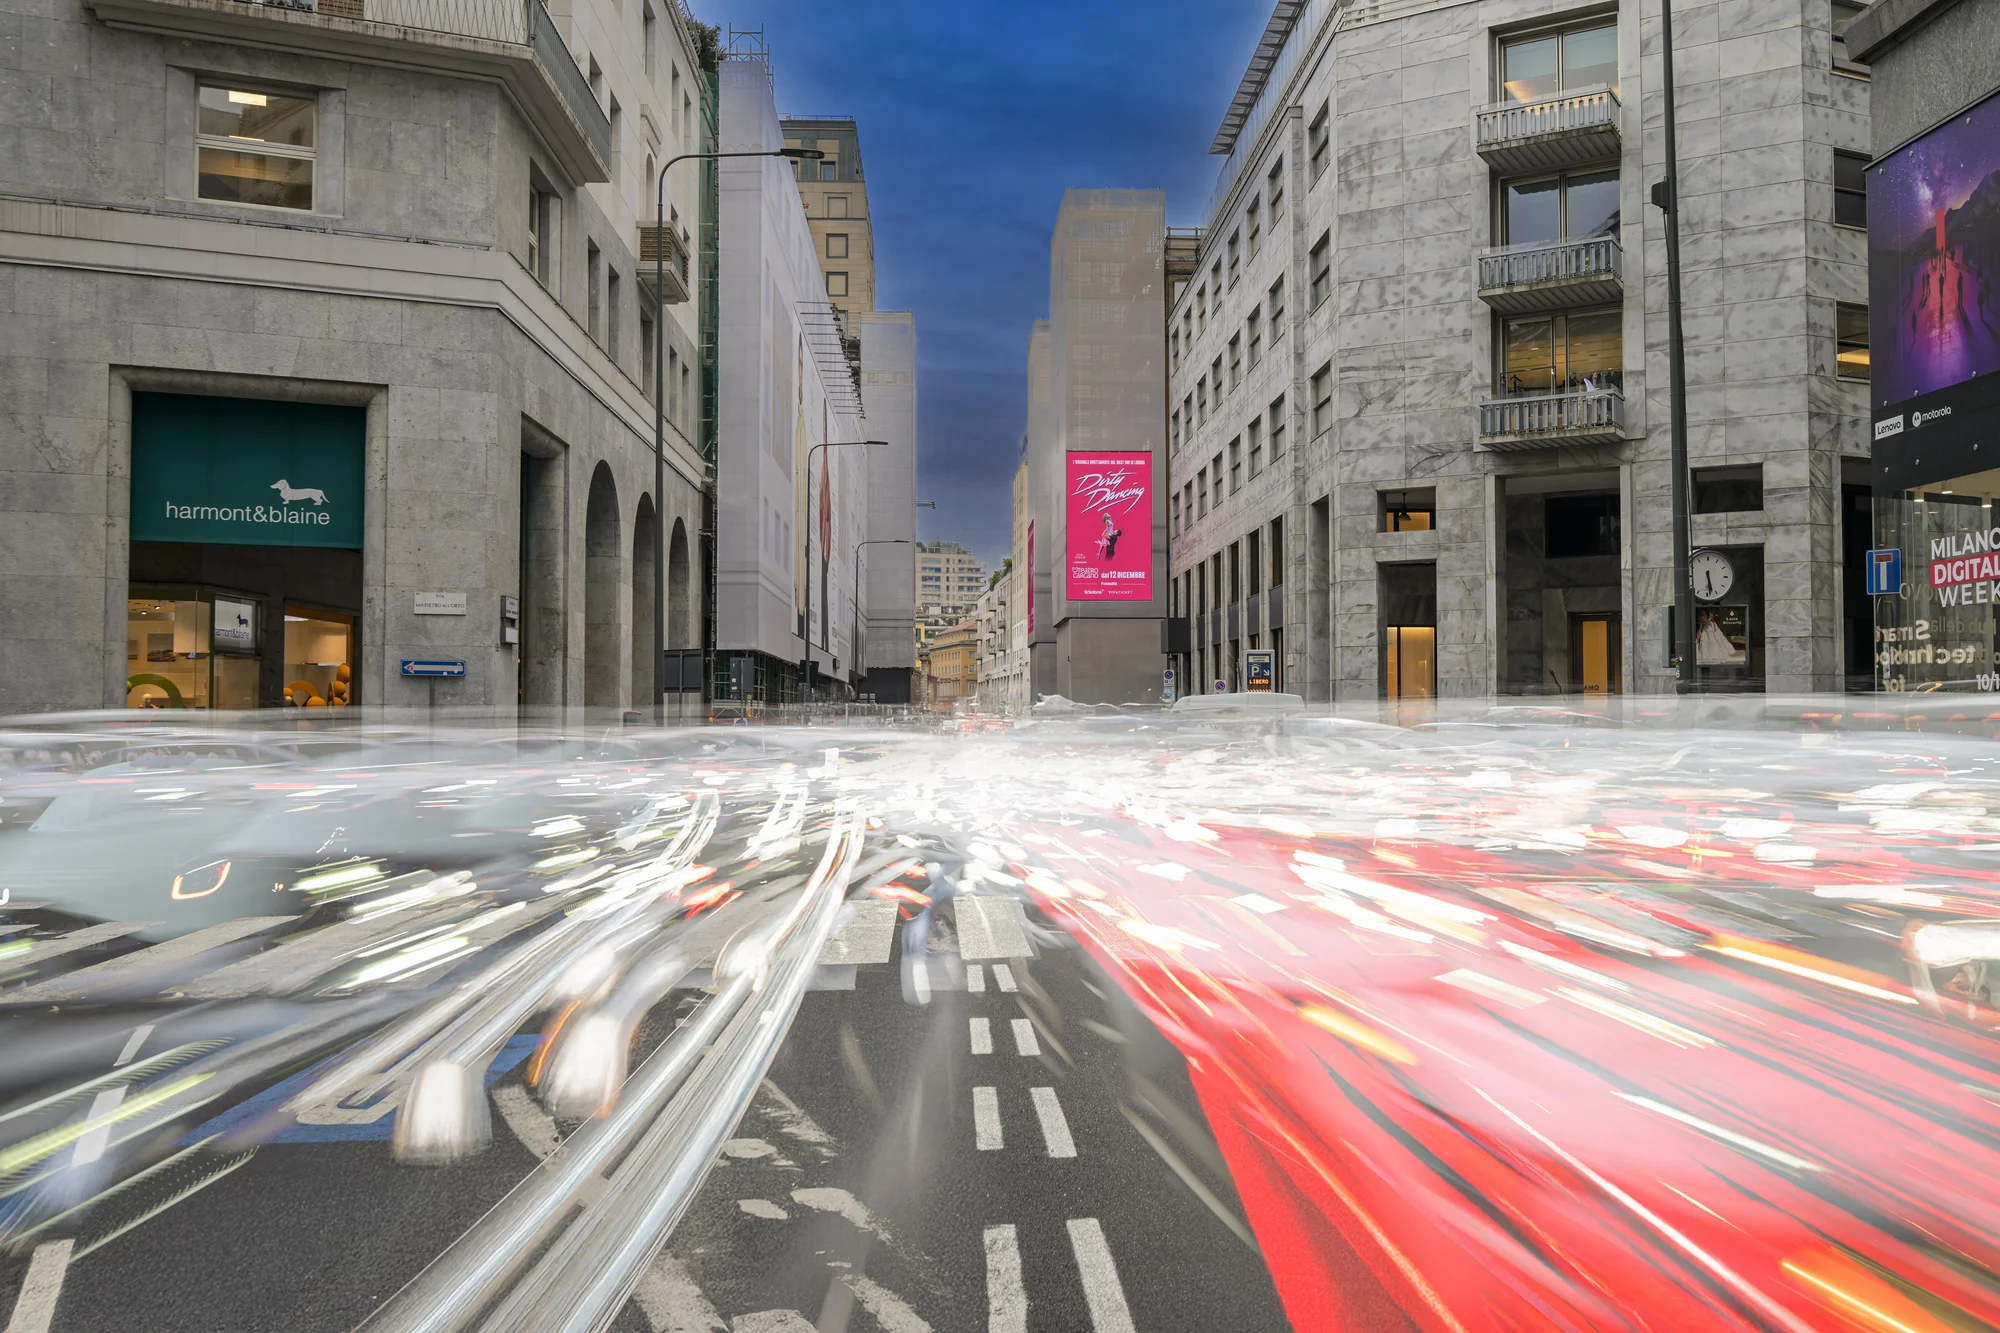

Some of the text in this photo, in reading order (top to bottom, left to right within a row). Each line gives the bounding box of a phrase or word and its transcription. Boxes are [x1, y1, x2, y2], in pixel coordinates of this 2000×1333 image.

[1921, 406, 1952, 421] motorola
[1877, 421, 1902, 435] Lenovo
[1072, 468, 1137, 496] Dirty
[1080, 482, 1146, 515] Dancing
[166, 501, 330, 525] harmont&blaine
[1931, 527, 2000, 560] MILANO
[1109, 571, 1117, 579] 12
[1117, 571, 1146, 579] DICEMBRE
[1934, 555, 2000, 585] DIGITAL
[1938, 580, 2000, 608] WEEK
